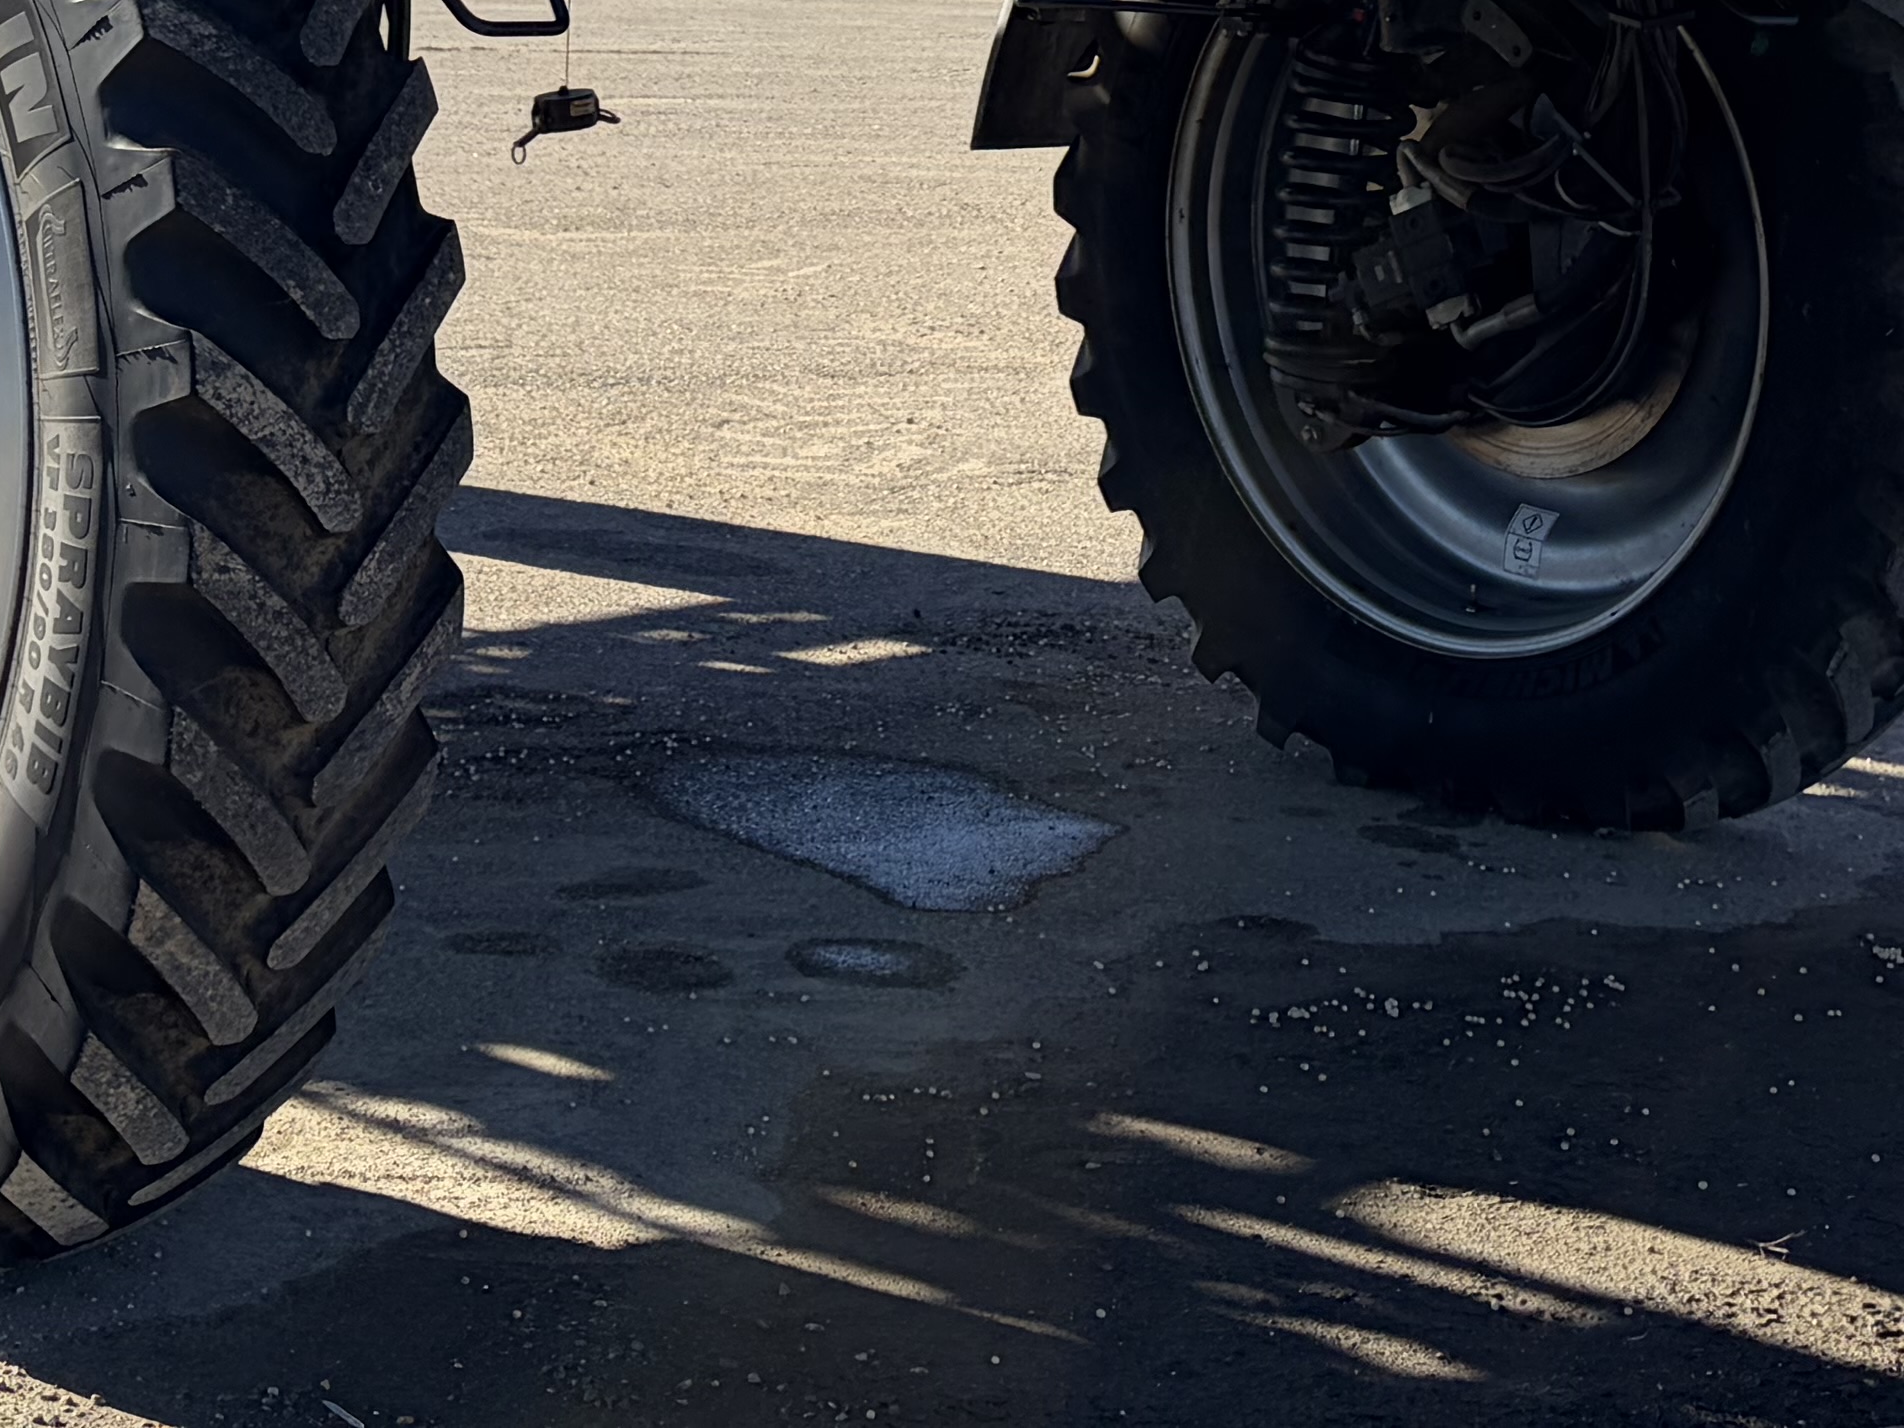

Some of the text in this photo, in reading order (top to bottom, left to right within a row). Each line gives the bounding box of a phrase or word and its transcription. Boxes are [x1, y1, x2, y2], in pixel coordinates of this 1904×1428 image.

[46, 433, 61, 492] VF
[26, 453, 95, 796] SPRAYBIB
[28, 507, 57, 671] 380/90
